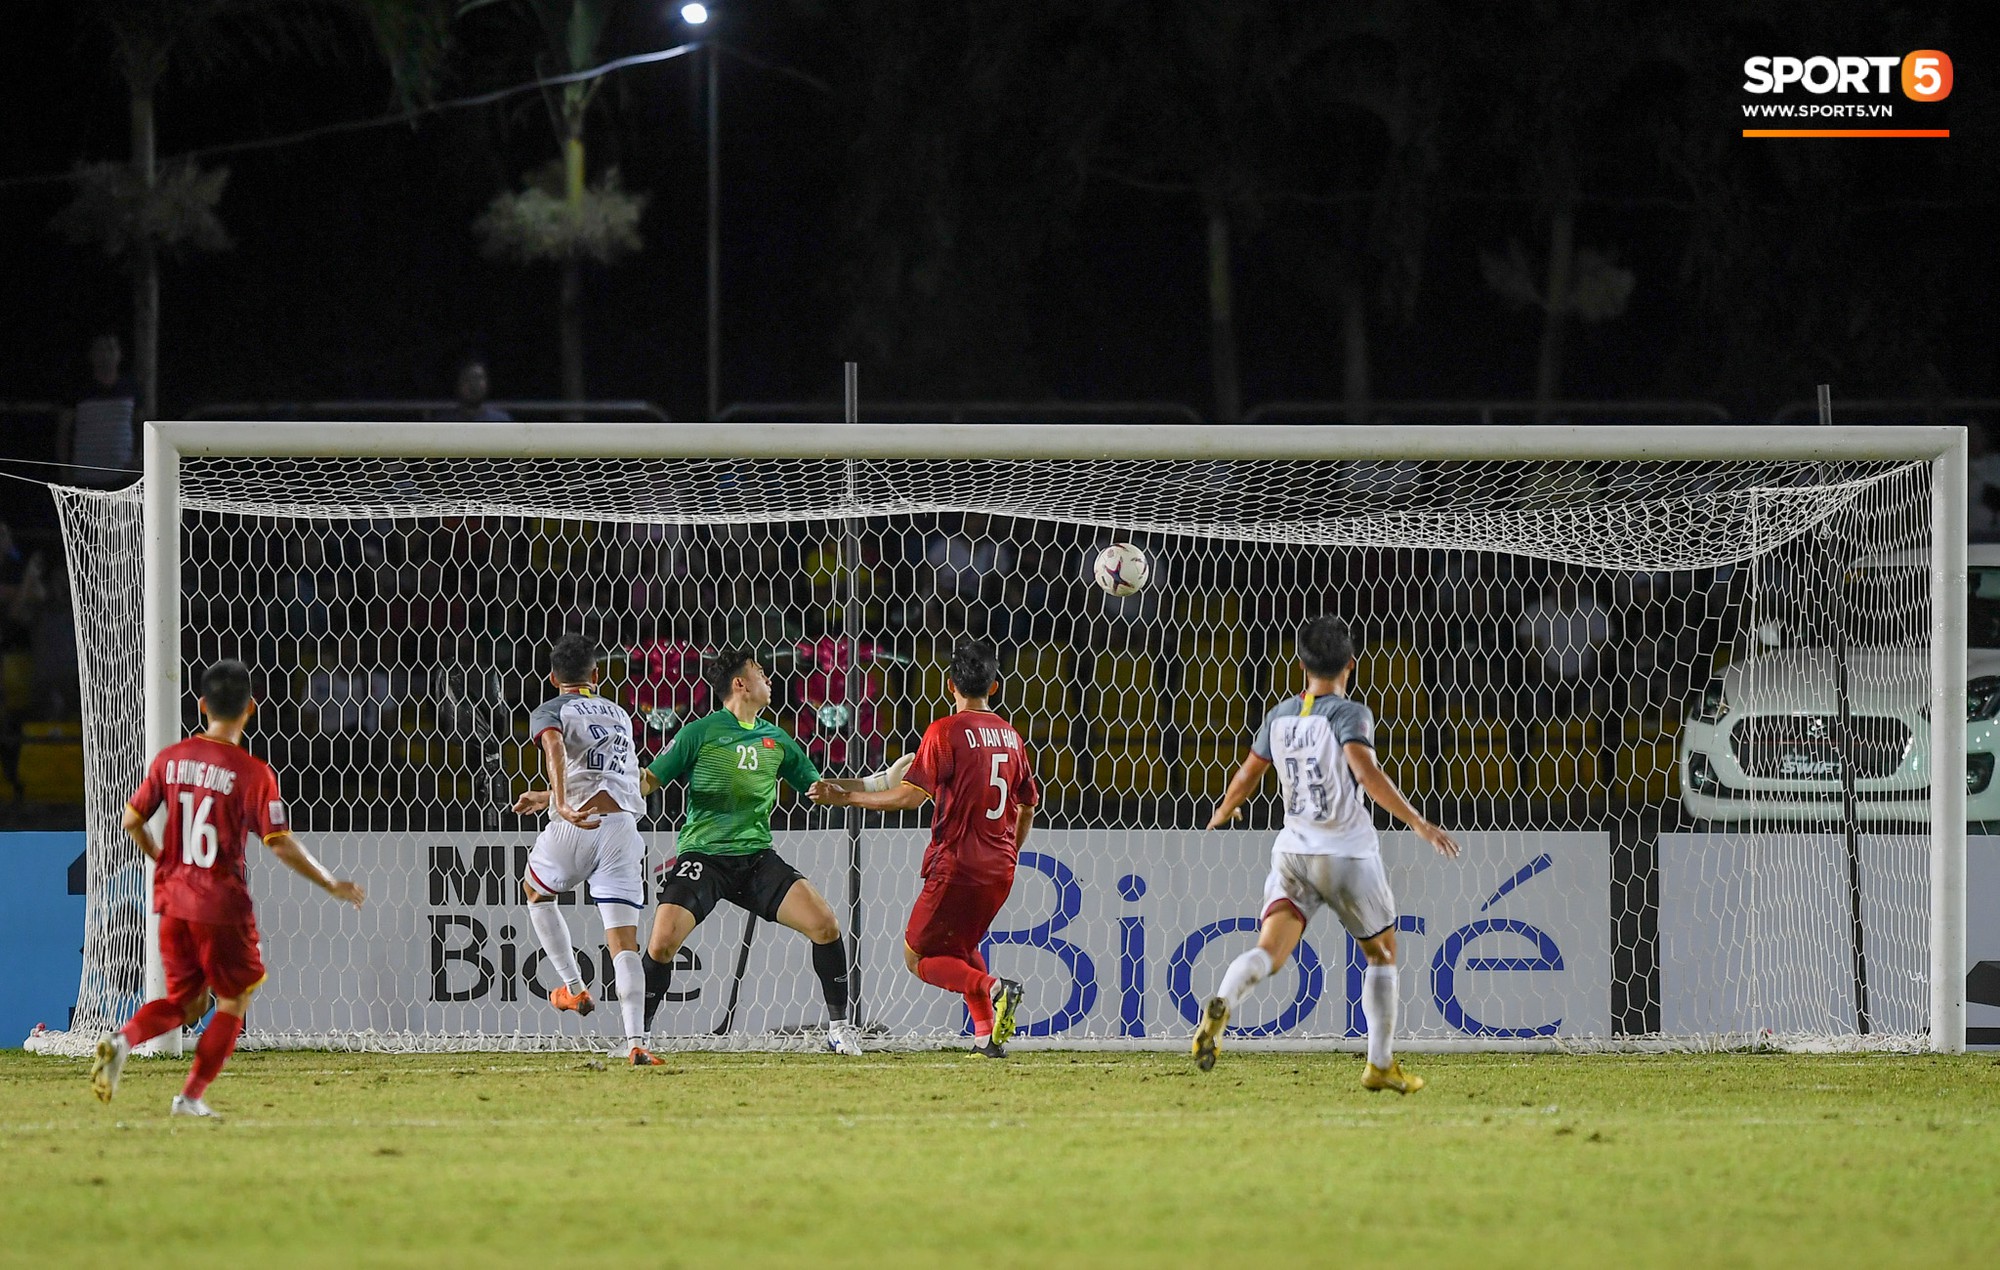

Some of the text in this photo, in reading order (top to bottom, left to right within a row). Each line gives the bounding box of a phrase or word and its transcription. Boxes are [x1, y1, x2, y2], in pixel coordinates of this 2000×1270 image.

[736, 744, 760, 770] 23
[965, 729, 980, 749] D.
[979, 728, 1001, 747] VAN
[176, 759, 207, 787] HUNG
[203, 765, 237, 796] DUNG
[985, 753, 1009, 820] 5
[178, 791, 219, 869] 16
[676, 860, 704, 881] 23
[960, 851, 1566, 1038] Bioré
